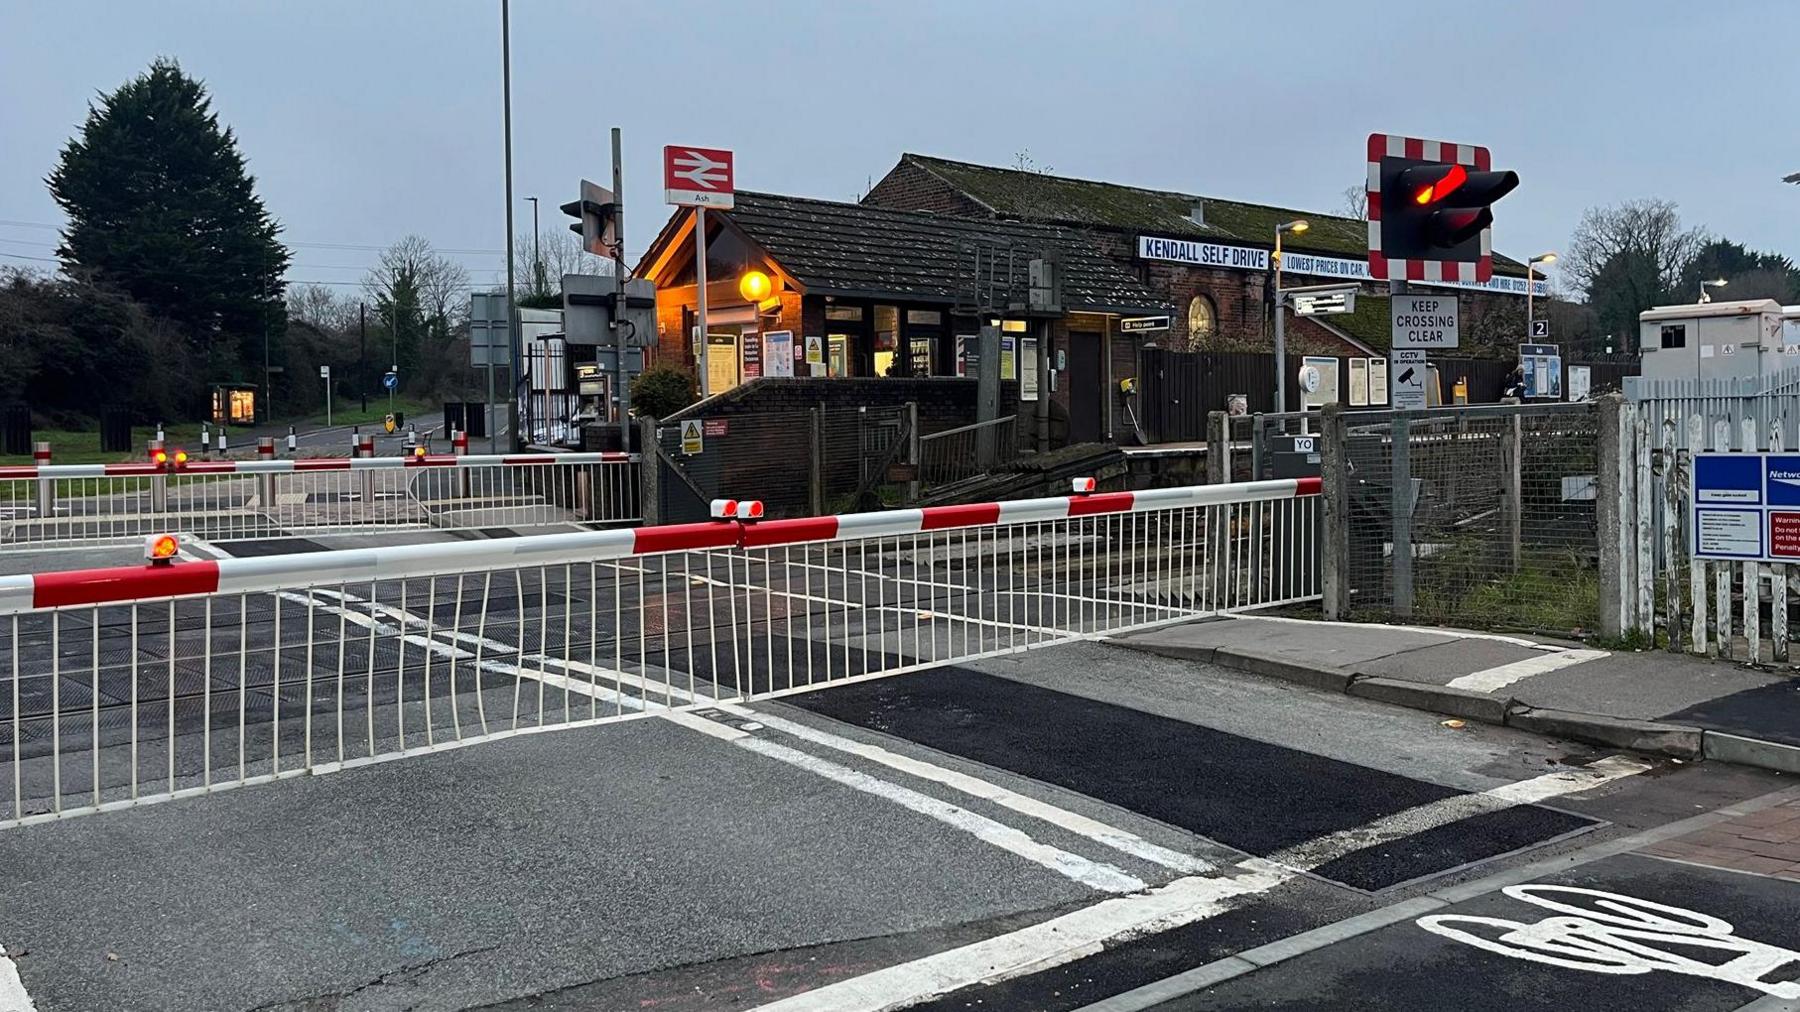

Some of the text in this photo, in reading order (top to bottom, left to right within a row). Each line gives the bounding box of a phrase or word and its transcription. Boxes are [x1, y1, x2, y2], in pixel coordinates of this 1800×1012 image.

[695, 194, 710, 202] Ash
[1146, 238, 1264, 268] KENDALL SELF DRIVE
[1287, 256, 1314, 272] LOWEST
[1315, 259, 1339, 274] PRICES
[1340, 262, 1349, 275] ON
[1411, 300, 1439, 313] KEEP
[1396, 316, 1454, 327] CROSSING
[1536, 322, 1545, 335] 2
[1408, 331, 1443, 342] CLEAR
[1296, 439, 1312, 450] YO
